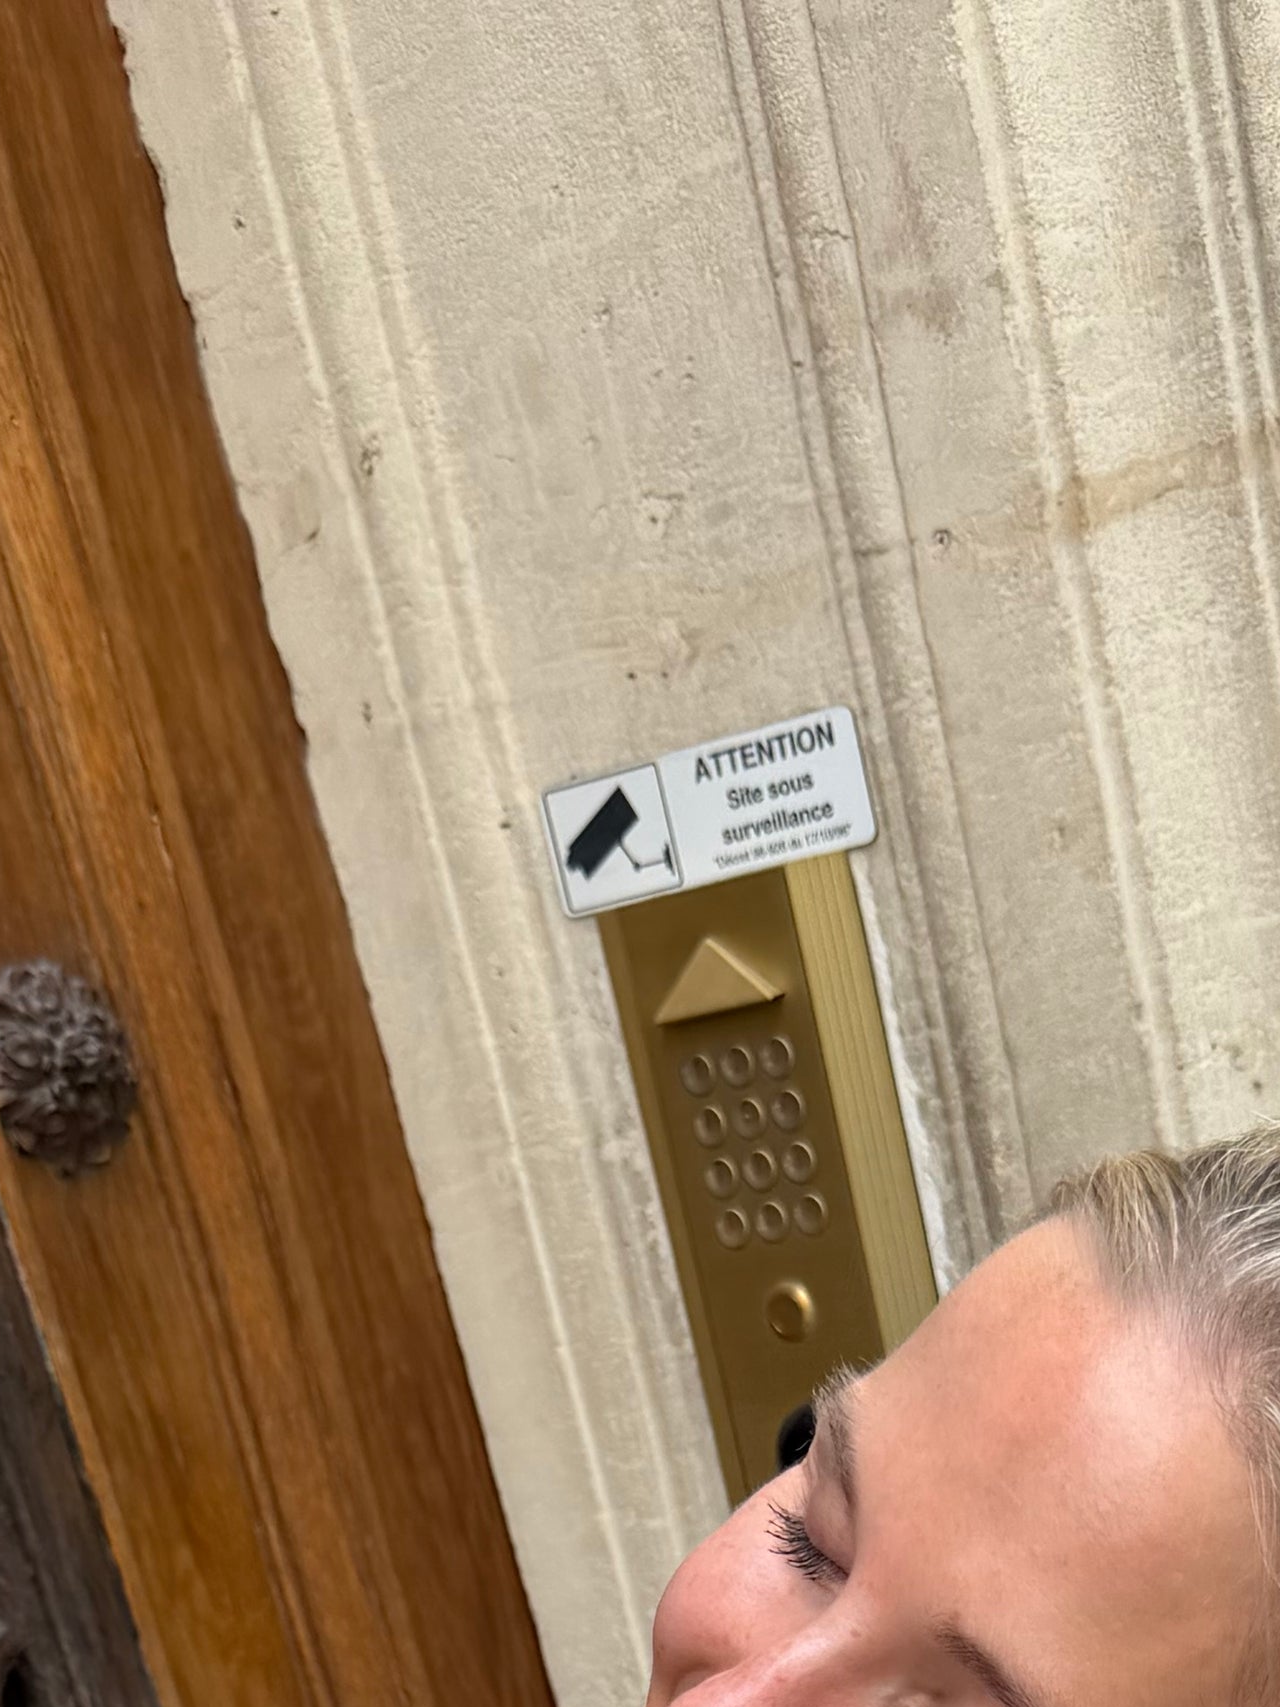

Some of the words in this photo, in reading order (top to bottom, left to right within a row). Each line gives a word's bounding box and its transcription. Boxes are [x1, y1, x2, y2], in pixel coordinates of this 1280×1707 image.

[696, 721, 835, 784] ATTENTION
[727, 786, 764, 810] Site
[767, 774, 814, 800] sous
[722, 802, 834, 845] surveillance
